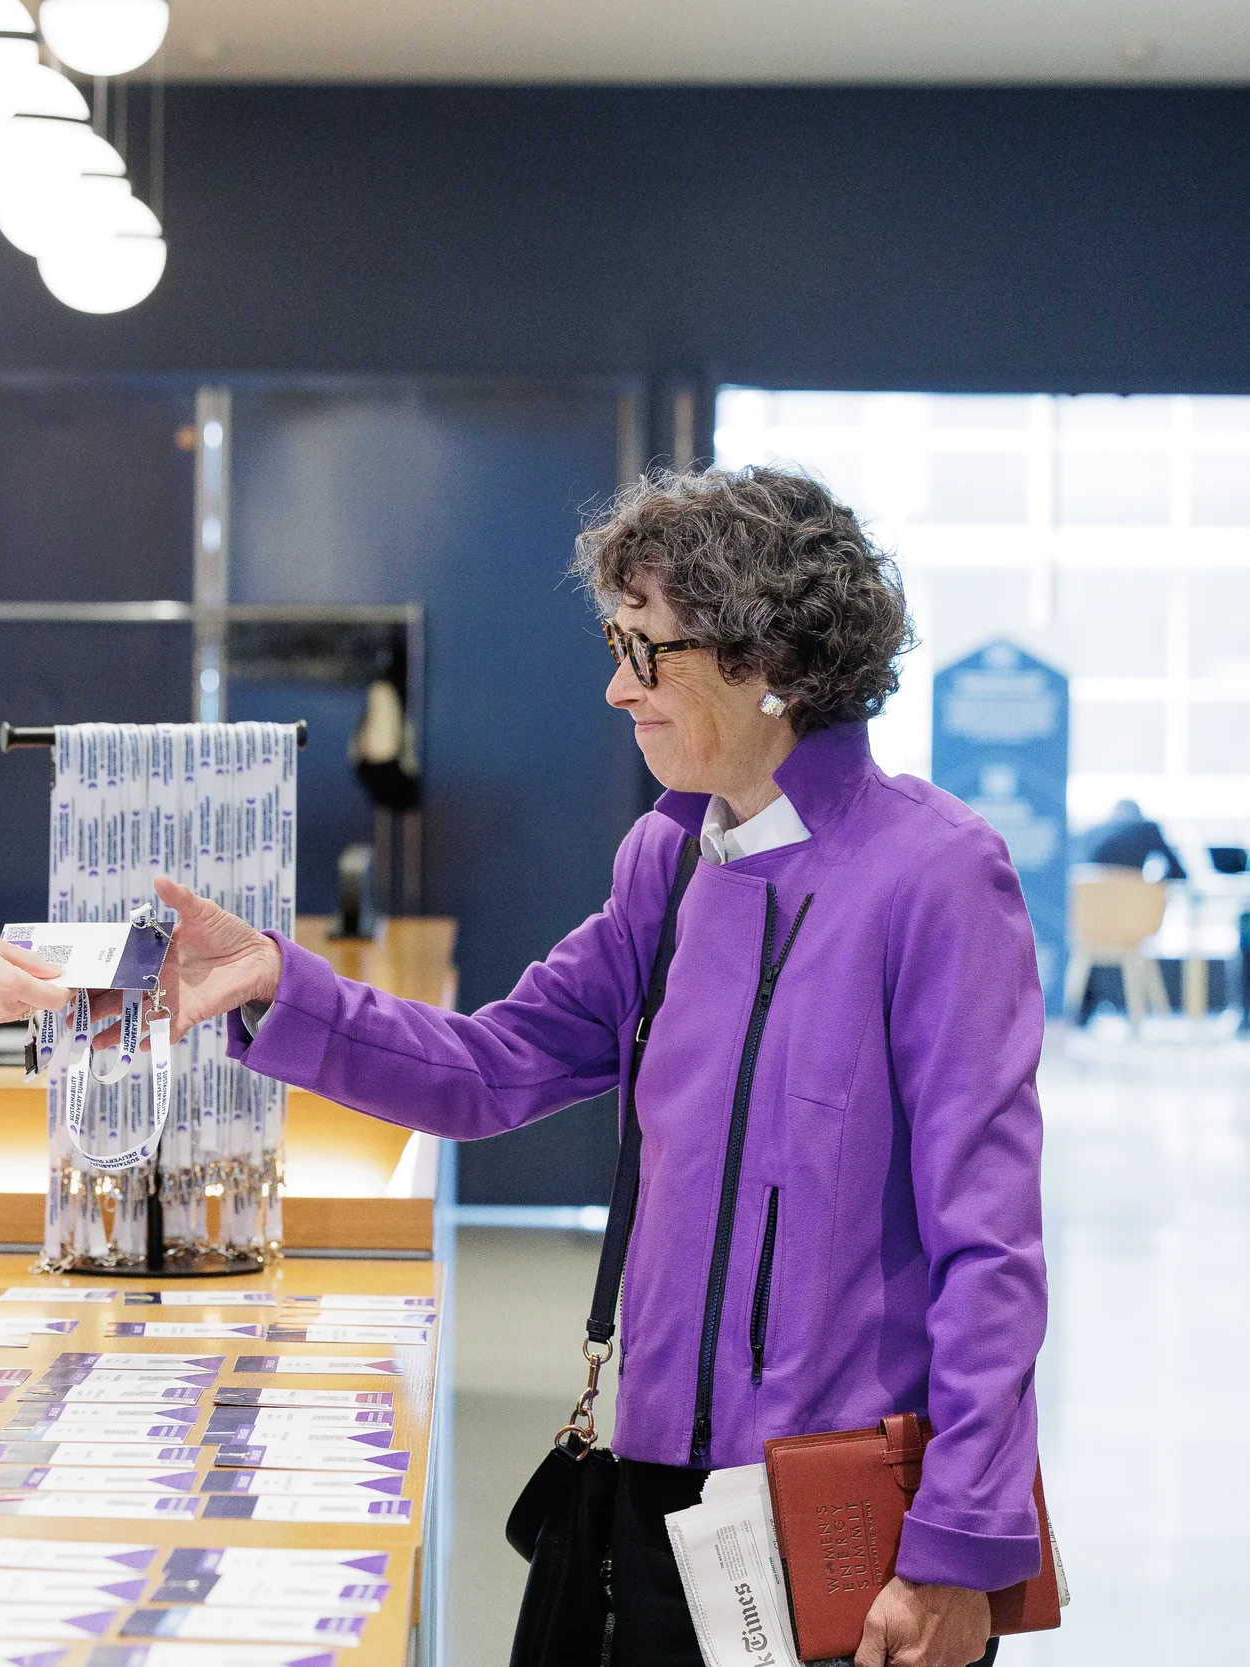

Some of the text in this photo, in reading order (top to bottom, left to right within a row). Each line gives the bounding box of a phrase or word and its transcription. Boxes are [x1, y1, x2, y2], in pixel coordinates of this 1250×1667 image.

[123, 1007, 132, 1051] SUSTAINABILITY
[130, 1023, 138, 1054] DELIVERY
[69, 1075, 77, 1121] SUSTAINABILITY
[75, 1095, 83, 1125] DELIVERY
[105, 1151, 138, 1164] DELIVERY
[832, 1505, 855, 1592] ENERGY
[846, 1503, 870, 1590] SUMMIT
[734, 1583, 768, 1653] Times
